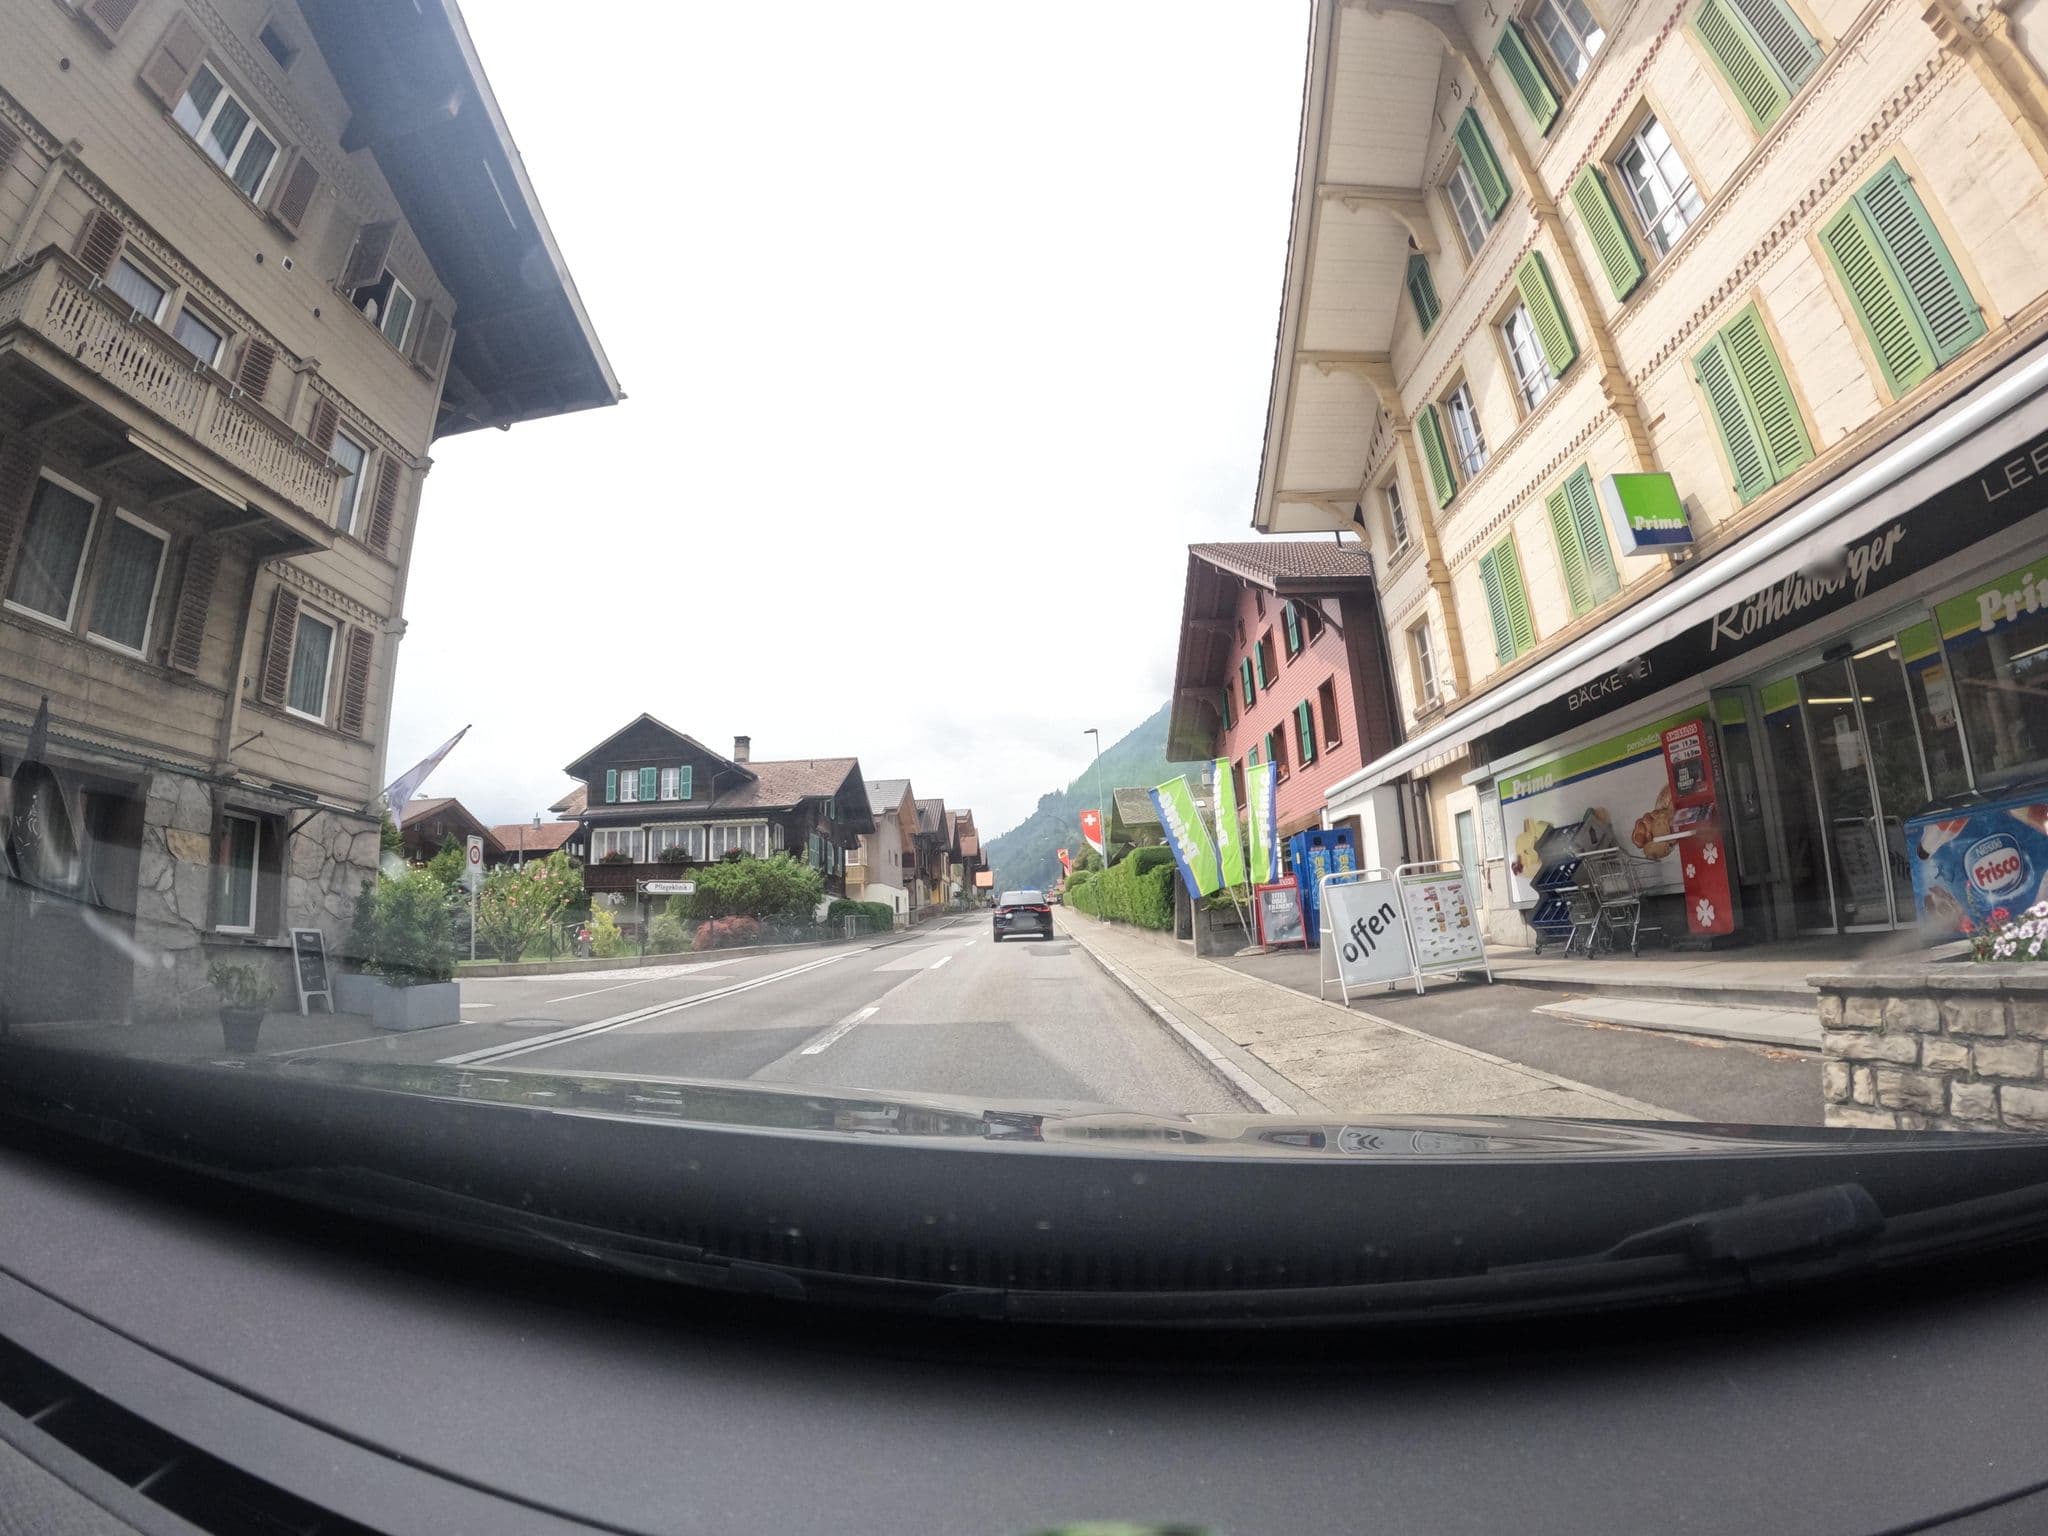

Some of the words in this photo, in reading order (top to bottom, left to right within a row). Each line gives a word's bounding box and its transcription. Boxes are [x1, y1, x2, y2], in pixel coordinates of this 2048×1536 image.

[1633, 514, 1683, 531] Prima
[1568, 657, 1653, 711] BÄCKEEI
[1511, 773, 1554, 800] Prima
[1975, 856, 2020, 887] Frisco
[1342, 902, 1396, 963] offen
